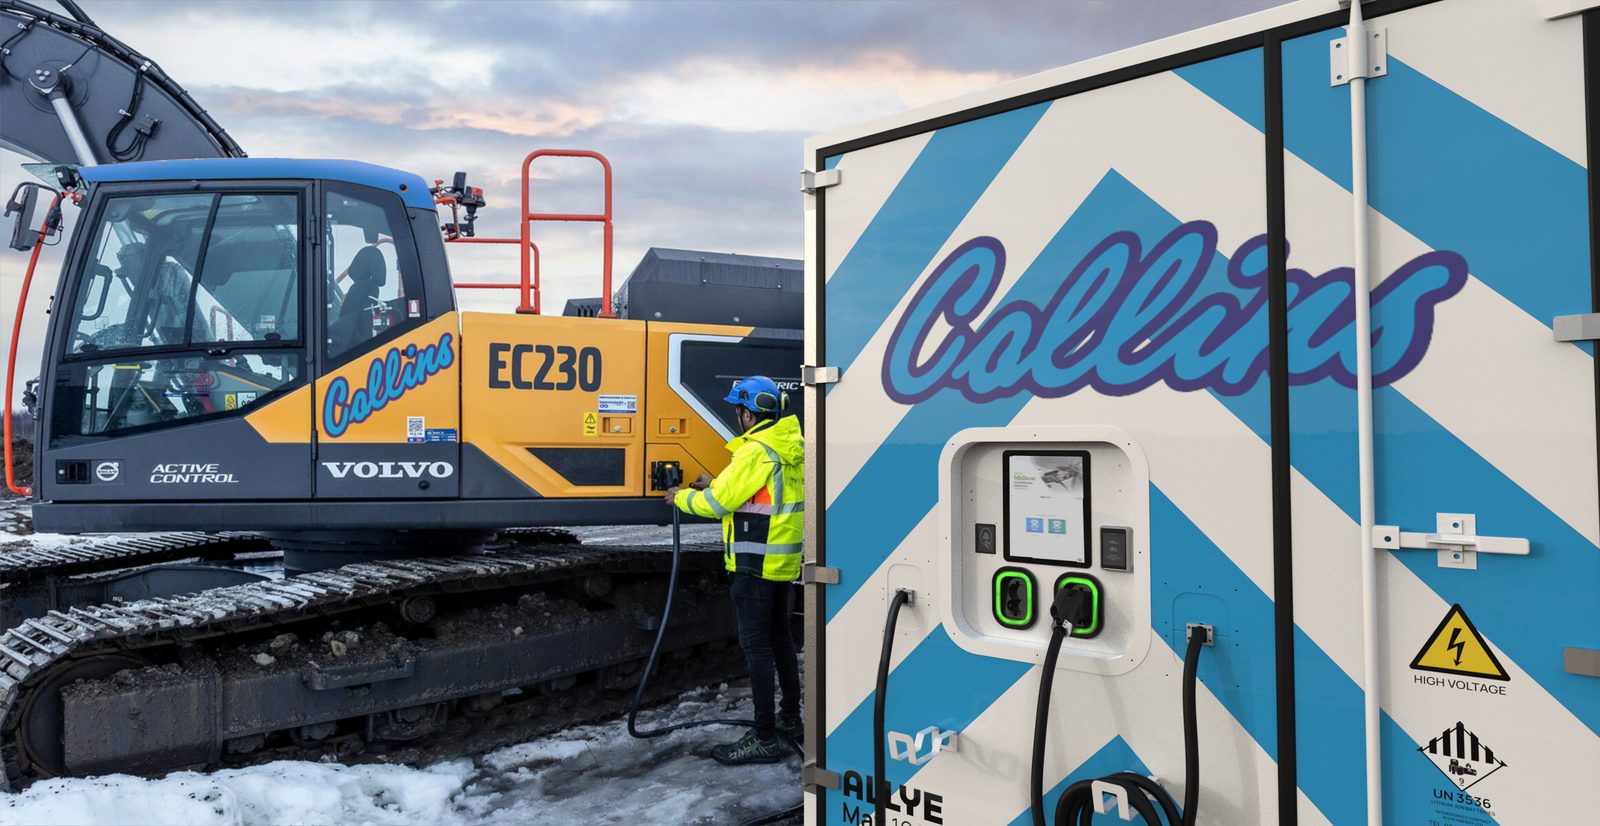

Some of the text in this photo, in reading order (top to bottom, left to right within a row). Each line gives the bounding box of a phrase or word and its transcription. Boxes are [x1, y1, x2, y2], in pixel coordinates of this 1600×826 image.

[880, 219, 1469, 405] Collins
[488, 342, 602, 392] EC230
[322, 332, 455, 438] Collins
[150, 473, 239, 484] CONTROL
[152, 463, 220, 473] ACTIVE
[321, 461, 454, 478] VOLVO
[1414, 675, 1507, 696] HIGH VOLTAGE
[1459, 777, 1465, 785] 9
[843, 770, 943, 825] ALLYE
[1433, 788, 1491, 809] UN 3536
[843, 802, 885, 826] Ma
